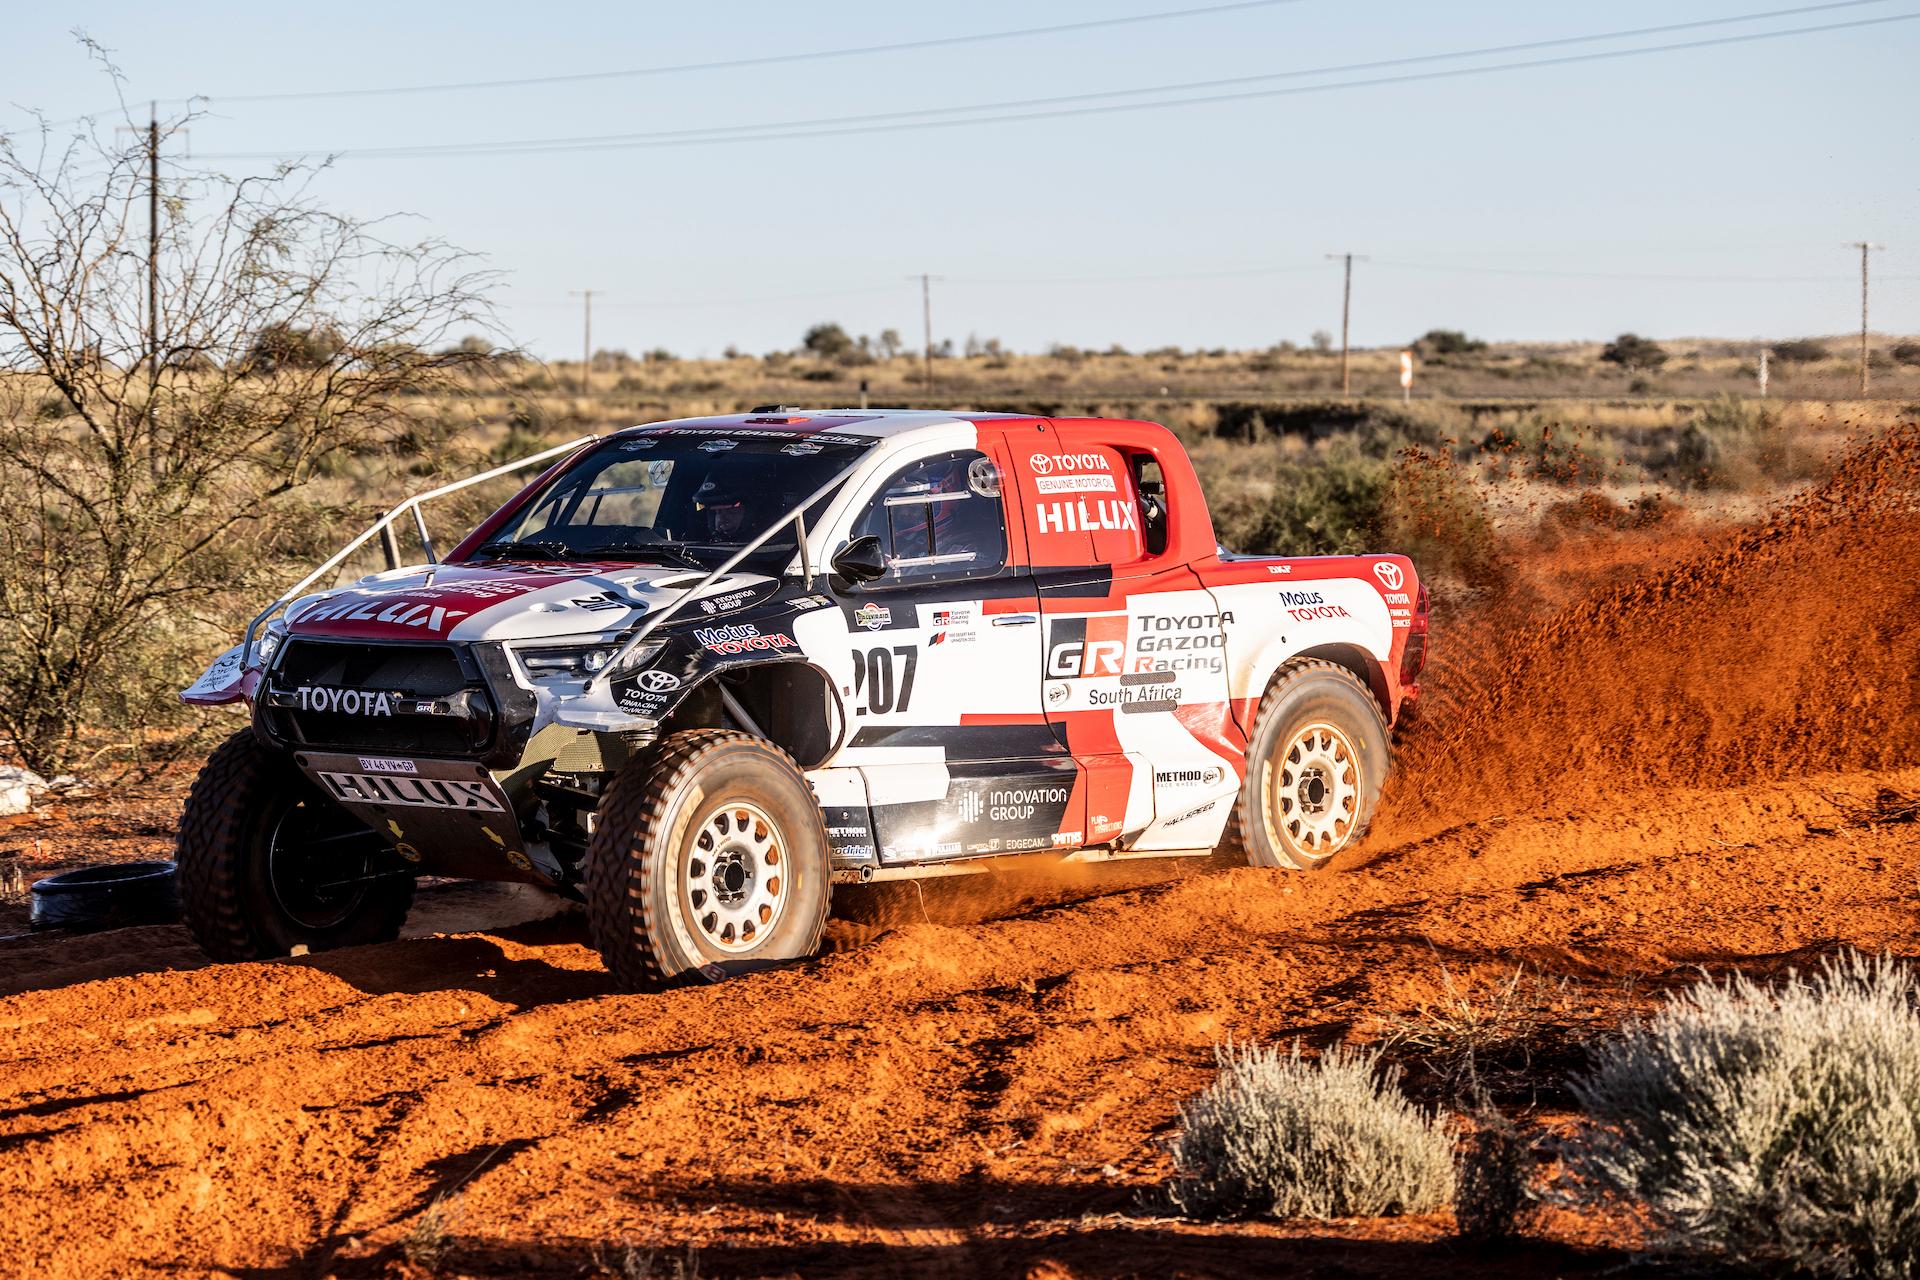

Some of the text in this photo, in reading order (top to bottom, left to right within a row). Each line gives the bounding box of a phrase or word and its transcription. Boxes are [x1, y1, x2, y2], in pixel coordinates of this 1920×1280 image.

[1052, 454, 1110, 471] TOYOTA
[1039, 478, 1114, 490] GENUINE MOTOR OIL
[1036, 500, 1137, 533] HILUX
[712, 589, 756, 604] INNOVATION
[1279, 591, 1324, 607] Motus
[1384, 593, 1410, 604] TOYOTA
[719, 600, 742, 611] GROUP
[1287, 605, 1352, 622] TOYOTA
[296, 601, 468, 632] HILUX
[1137, 611, 1235, 632] TOYOTA
[693, 624, 761, 646] Motus
[1136, 632, 1227, 653] GAZOO
[706, 634, 799, 656] TOYOTA
[1048, 640, 1125, 677] GR
[1134, 653, 1223, 675] Racing
[297, 686, 392, 717] TOYOTA
[624, 688, 668, 703] TOYOTA
[1089, 684, 1183, 705] South Africa
[620, 699, 658, 710] FINANCIAL
[401, 761, 415, 771] GP
[1156, 771, 1201, 782] METHOD
[320, 774, 502, 809] HILUX
[990, 788, 1067, 806] INNOVATION
[990, 805, 1035, 821] GROUP
[1006, 838, 1045, 850] EDGECAM
